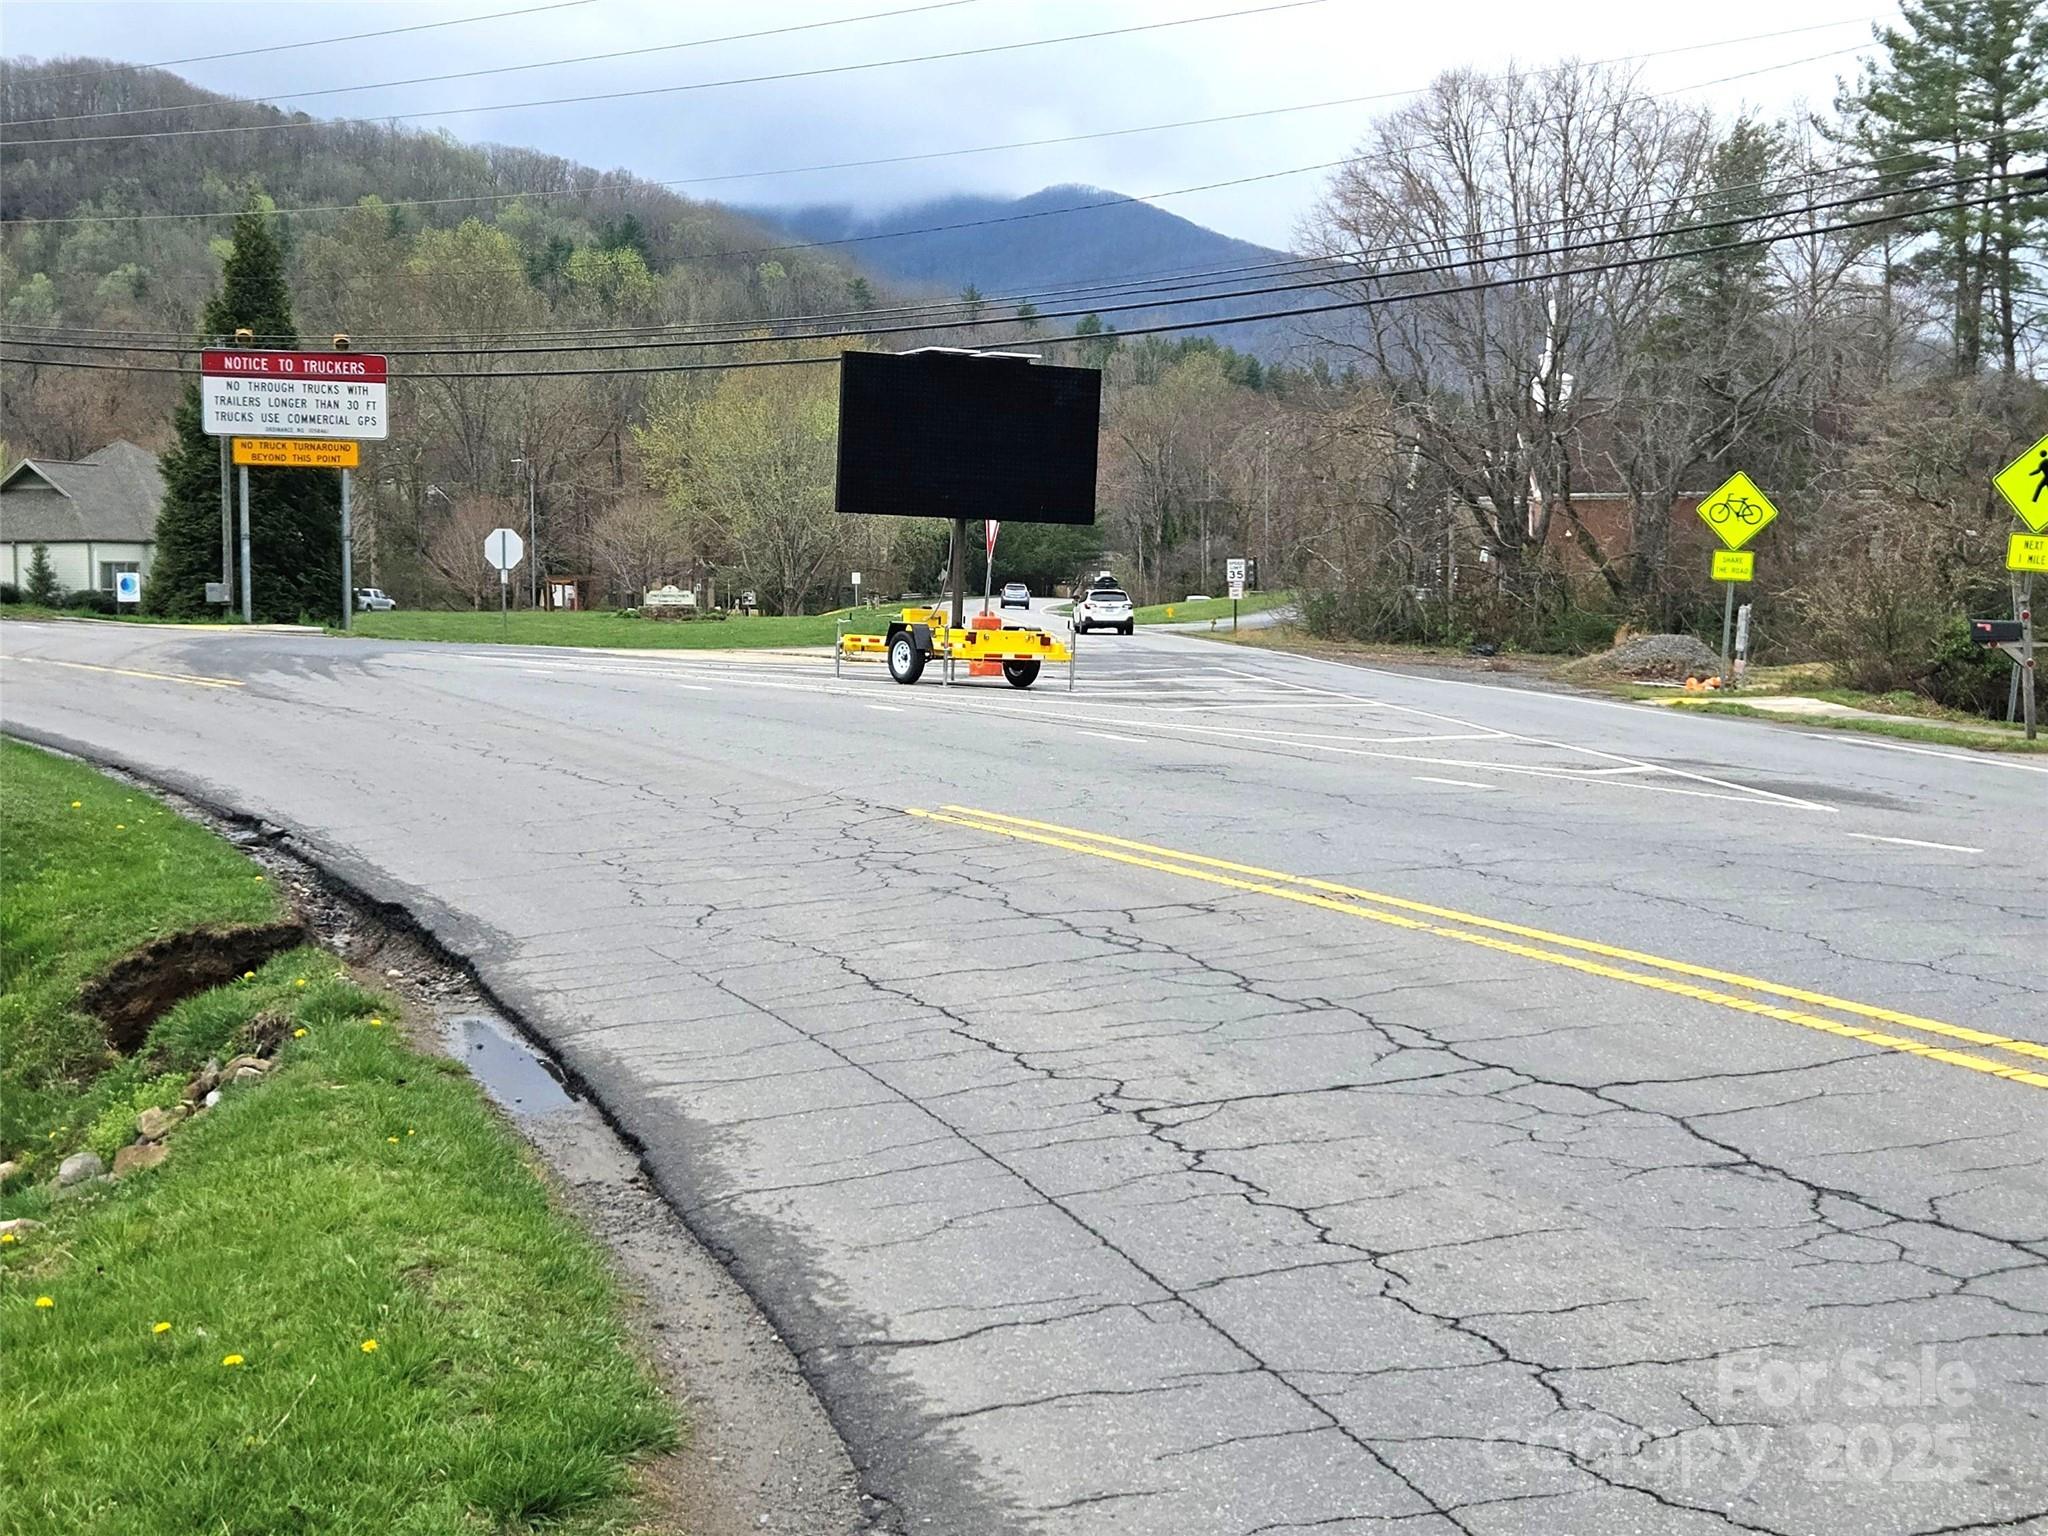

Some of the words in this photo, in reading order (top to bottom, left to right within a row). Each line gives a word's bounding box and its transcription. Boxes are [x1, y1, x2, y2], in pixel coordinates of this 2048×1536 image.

[224, 356, 268, 371] NOTICE
[278, 358, 293, 371] TO
[303, 360, 366, 375] TRUCKERS
[226, 381, 240, 391] NO
[248, 382, 294, 393] THROUGH
[303, 384, 339, 395] TRUCKS
[347, 385, 368, 395] WITH
[214, 396, 261, 407] TRAILERS
[268, 398, 307, 409] LONGER
[315, 399, 340, 410] THAN
[347, 400, 359, 410] 30
[366, 401, 376, 411] FT
[215, 411, 254, 422] TRUCKS
[261, 413, 280, 423] USE
[288, 414, 350, 425] COMMERCIAL
[358, 416, 377, 426] GPS
[241, 442, 253, 450] NO
[259, 442, 287, 450] TRUCK
[294, 443, 351, 452] TURNAROUND
[251, 453, 286, 462] BEYOND
[2024, 539, 2044, 550] NEXT
[2027, 554, 2046, 565] MILE
[1229, 570, 1244, 579] 35
